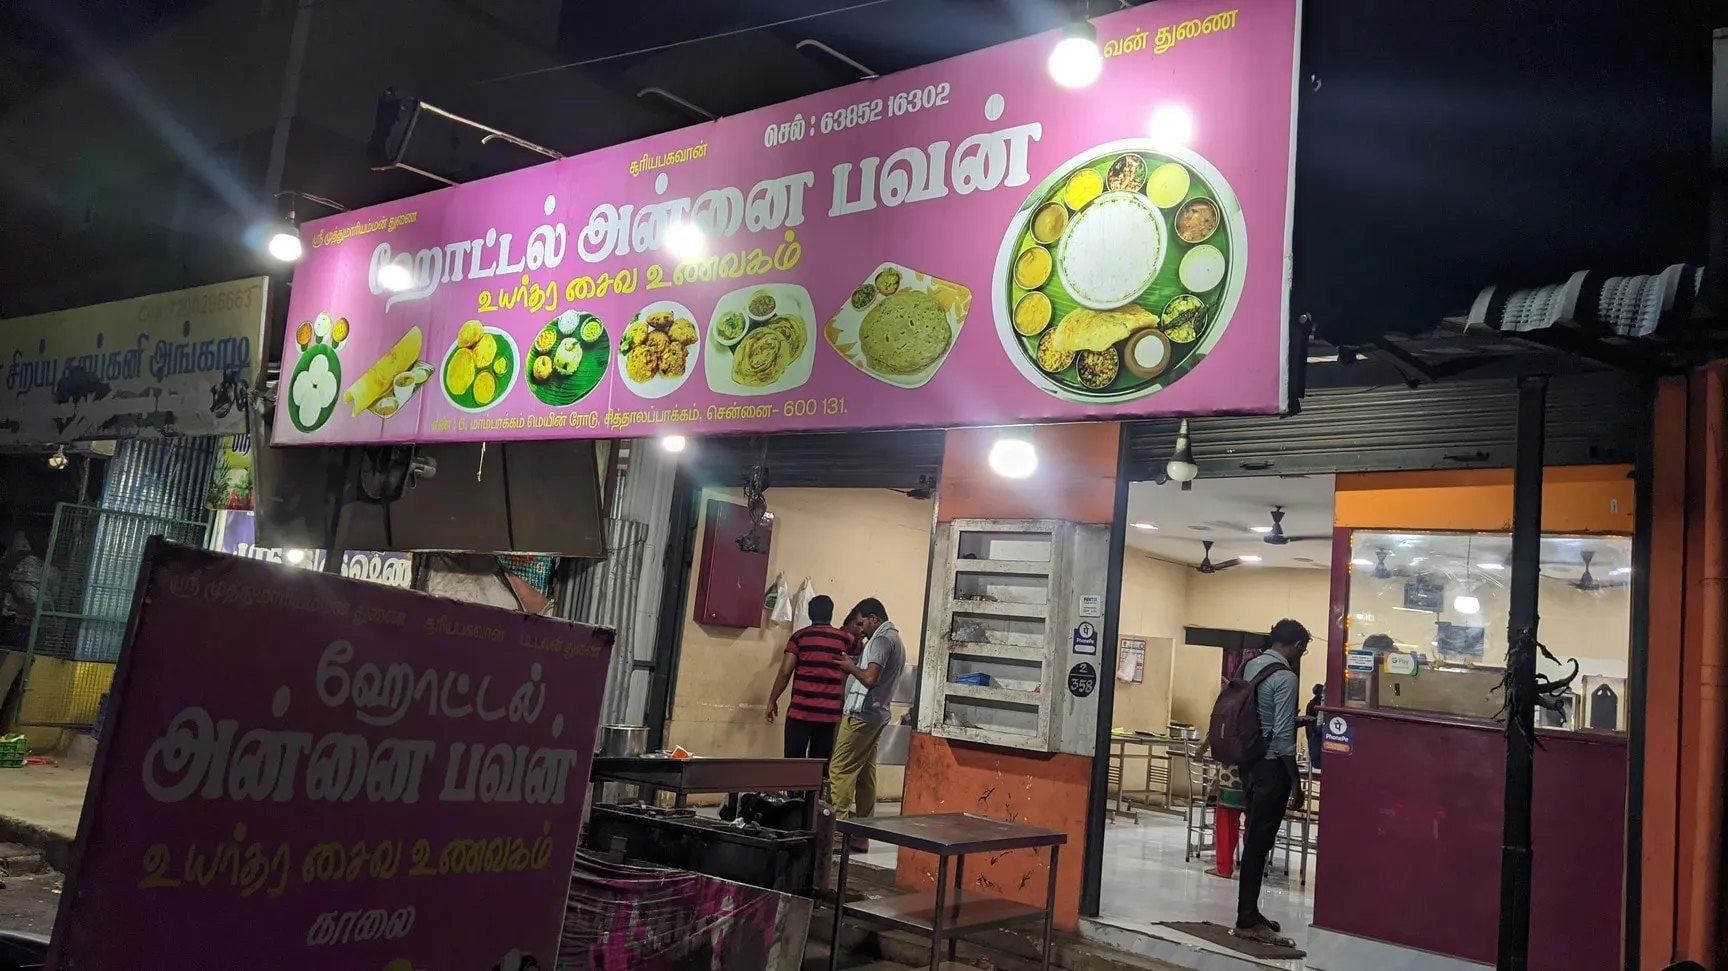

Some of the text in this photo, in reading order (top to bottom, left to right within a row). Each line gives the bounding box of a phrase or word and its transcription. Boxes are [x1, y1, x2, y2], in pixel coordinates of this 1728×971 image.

[1153, 9, 1239, 54] துணை
[765, 113, 805, 148] செல்
[820, 97, 882, 135] 63852
[888, 82, 951, 118] 16302
[629, 140, 708, 176] சூரியபகவான்
[368, 93, 1042, 314] ஹோட்டல் அன்னை பவன்
[477, 230, 802, 313] உயர்தர சைவ உணவகம்
[6, 338, 58, 398] சிறப்பு
[783, 399, 817, 417] 600
[315, 639, 546, 726] ஹோட்டல்
[1070, 678, 1093, 693] 358
[1079, 663, 1088, 673] 2
[142, 685, 577, 805] அன்னை பவன்
[1325, 733, 1349, 743] PhonePe
[302, 837, 400, 884] சைவ
[408, 820, 553, 876] உணவகம்
[306, 905, 415, 946] காலை
